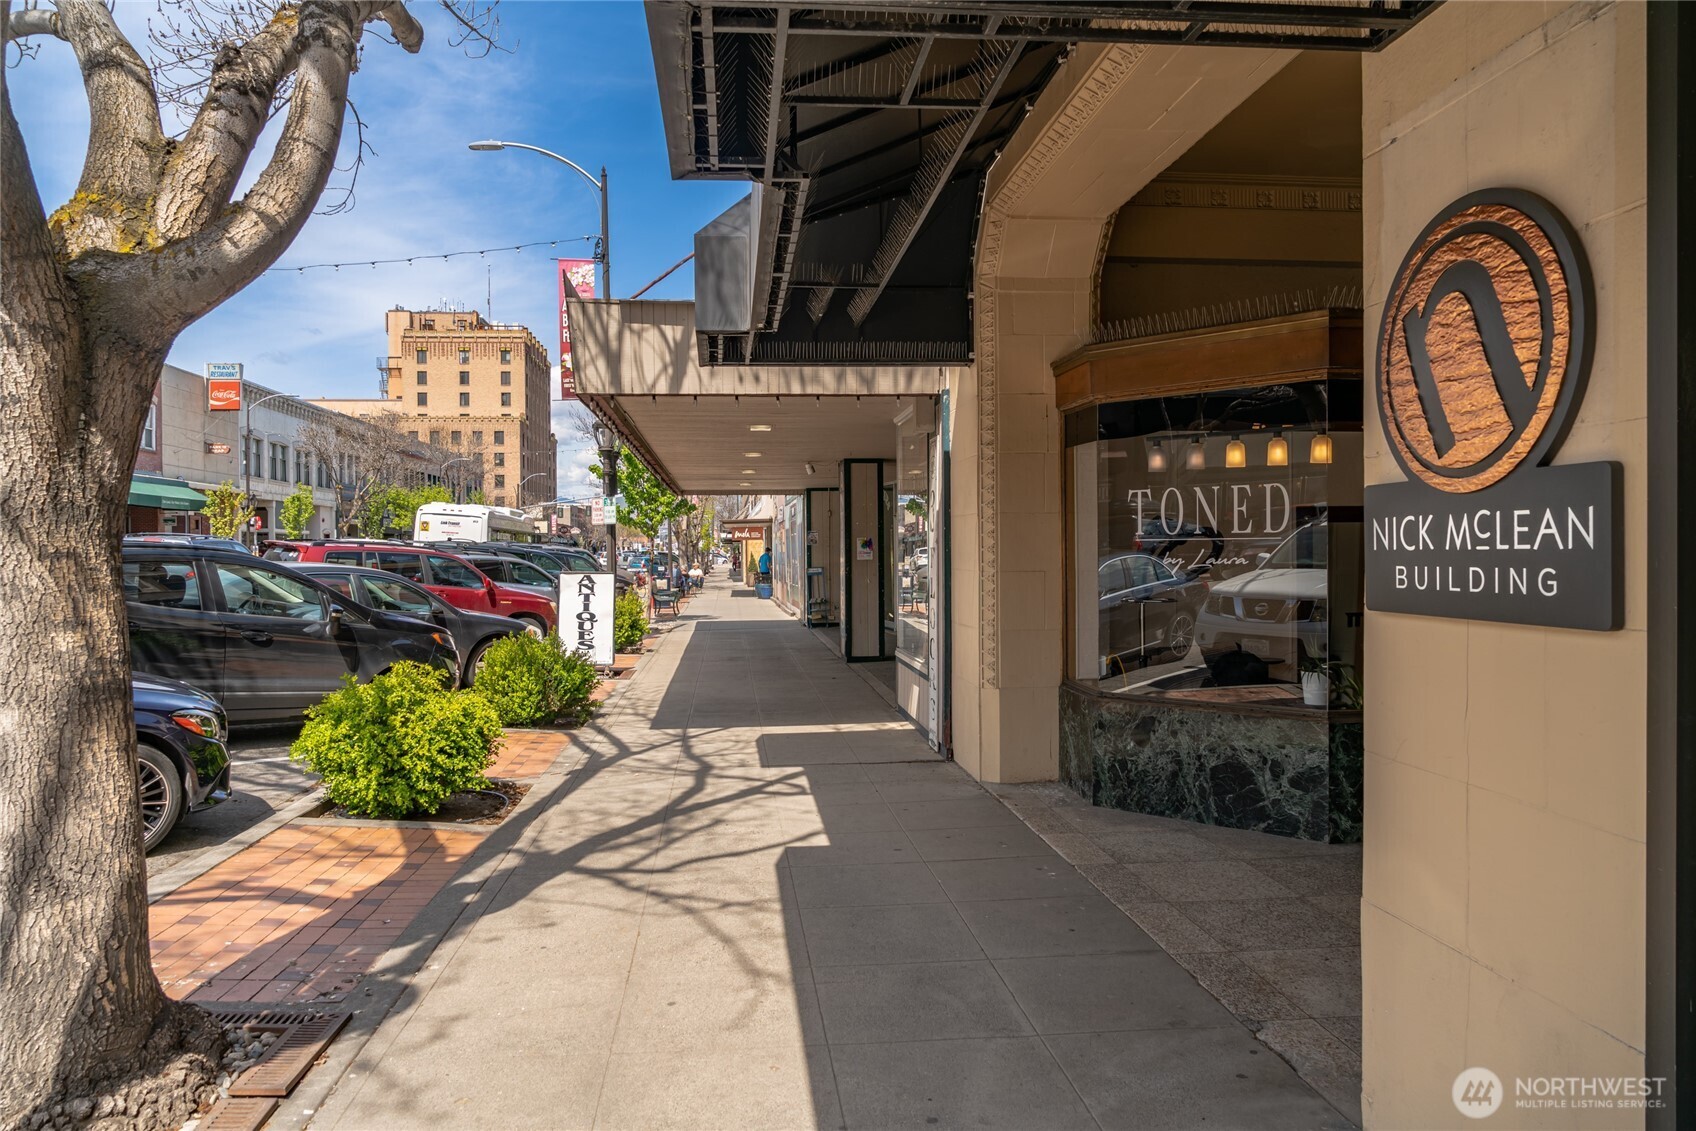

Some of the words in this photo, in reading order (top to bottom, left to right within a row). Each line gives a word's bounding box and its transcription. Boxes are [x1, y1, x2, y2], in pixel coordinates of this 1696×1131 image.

[1127, 482, 1291, 536] TONED
[1372, 514, 1435, 551] NICK
[1162, 550, 1185, 575] by
[1187, 548, 1249, 570] Laura
[1395, 565, 1558, 597] BUILDING
[575, 574, 598, 651] ANTIQUES
